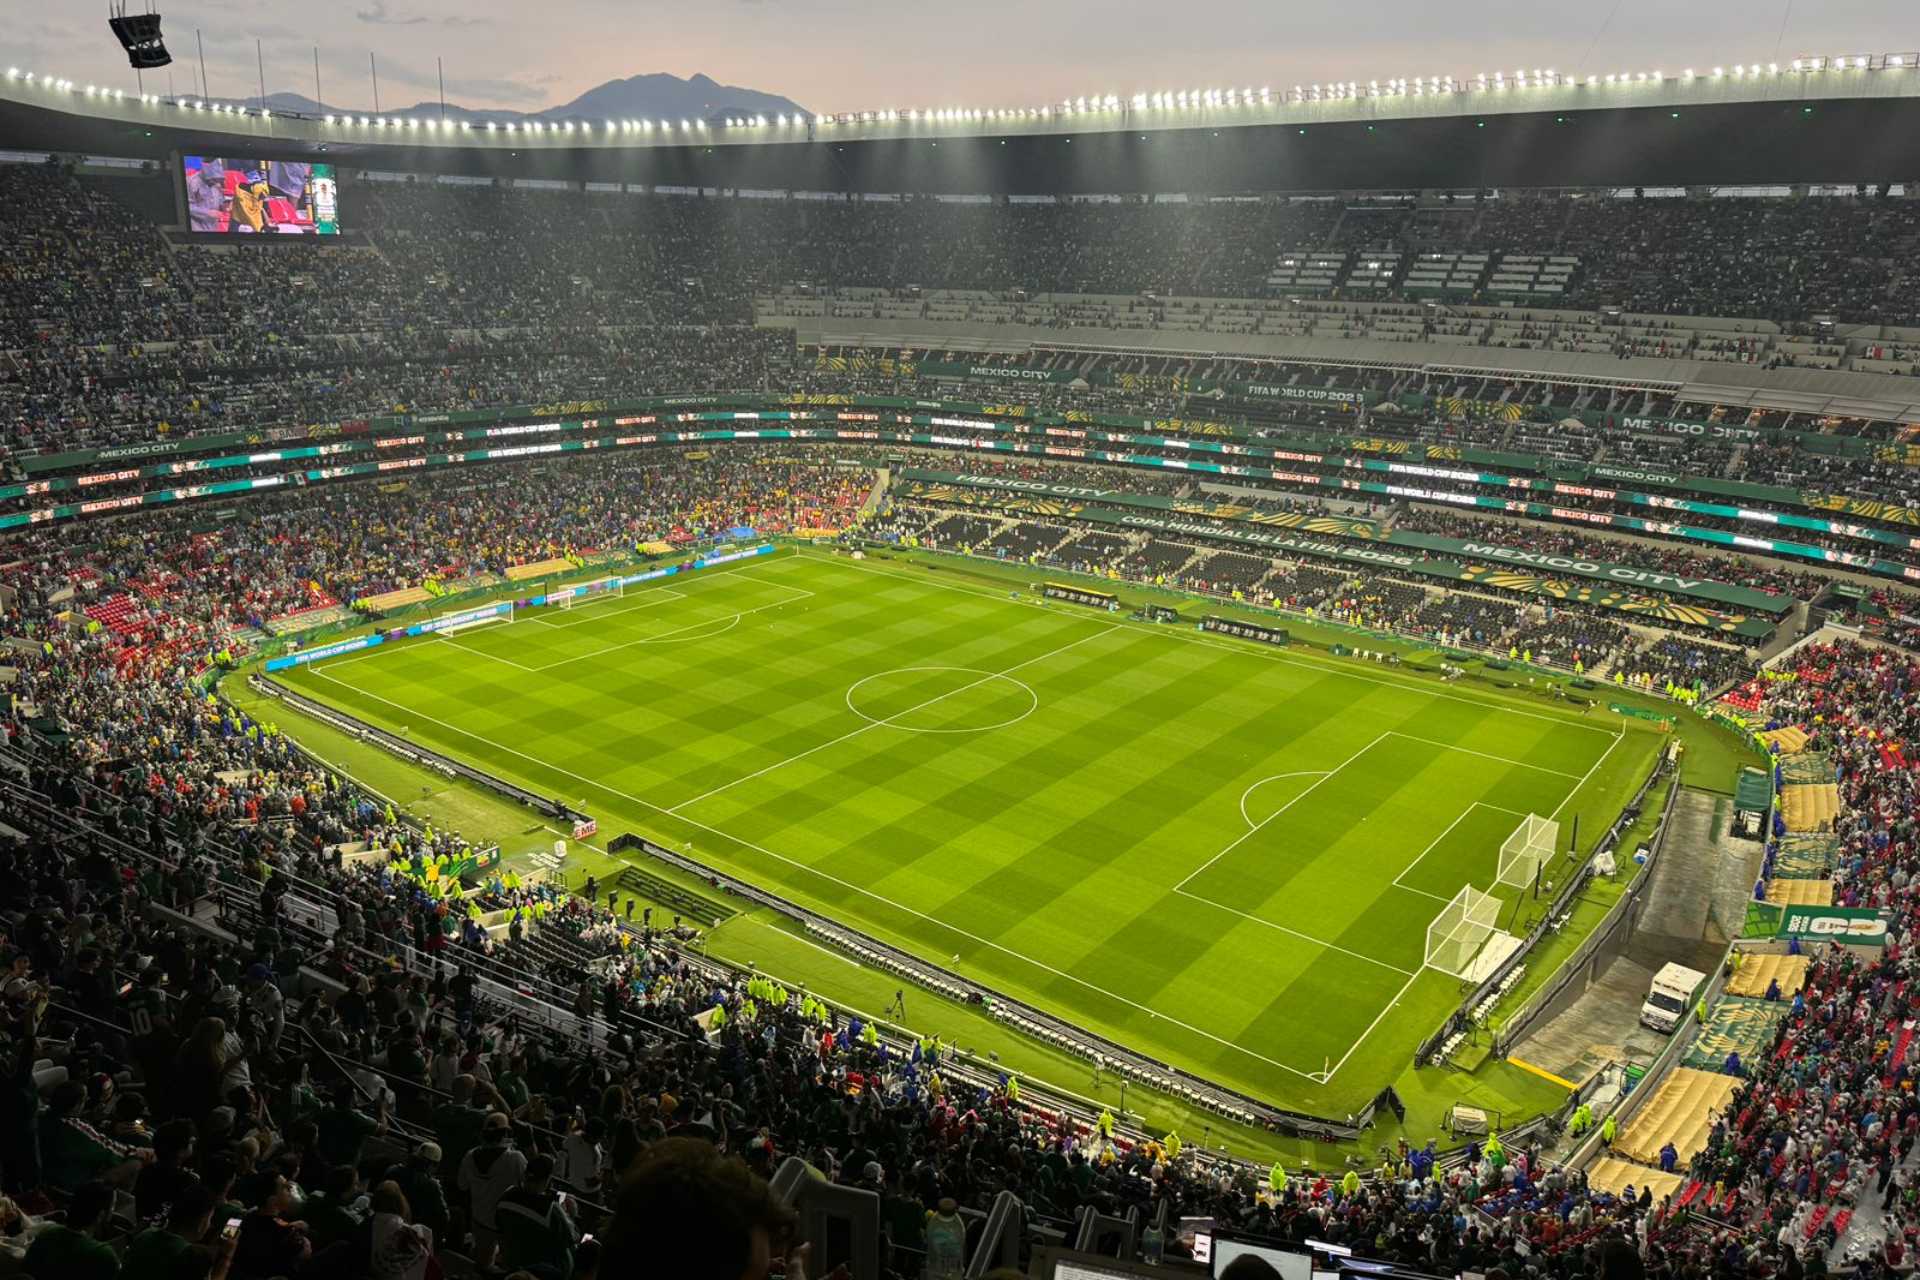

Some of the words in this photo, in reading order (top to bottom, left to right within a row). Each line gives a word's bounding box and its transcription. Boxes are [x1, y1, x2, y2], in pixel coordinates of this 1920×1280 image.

[970, 367, 1020, 377] MEXICO
[1022, 370, 1051, 379] CITY
[1249, 385, 1269, 395] FIFA
[1270, 387, 1306, 398] WORLD
[1307, 390, 1327, 399] CUP
[1623, 417, 1704, 435] MEICO
[408, 436, 425, 444] CITY
[100, 447, 149, 458] MEXICO
[151, 443, 180, 452] CITY
[1274, 451, 1304, 461] MEXICO
[78, 472, 116, 485] MEXICO
[118, 469, 140, 480] CITY
[1272, 471, 1302, 482] MEXICO
[1406, 464, 1433, 476] WORLD
[1434, 468, 1451, 478] CUP
[1595, 467, 1644, 479] MEXICO
[1647, 473, 1677, 484] CITY
[956, 474, 1047, 490] MEXICO
[1052, 485, 1119, 496] CITY
[1404, 487, 1431, 498] WORLD
[1555, 483, 1592, 496] MEXICO
[1593, 489, 1616, 499] CITY
[81, 499, 120, 512] MEXICO
[120, 496, 143, 506] CITY
[1551, 508, 1588, 520] MEXICO
[1589, 514, 1612, 524] CITY
[1121, 515, 1165, 528] COPA
[1246, 532, 1272, 542] DE
[1272, 536, 1296, 546] LA
[1300, 541, 1338, 553] FIFA
[1342, 548, 1414, 566] 2026
[1463, 543, 1600, 573] MEXICO
[1609, 568, 1700, 589] CITY
[129, 1007, 152, 1037] 10
